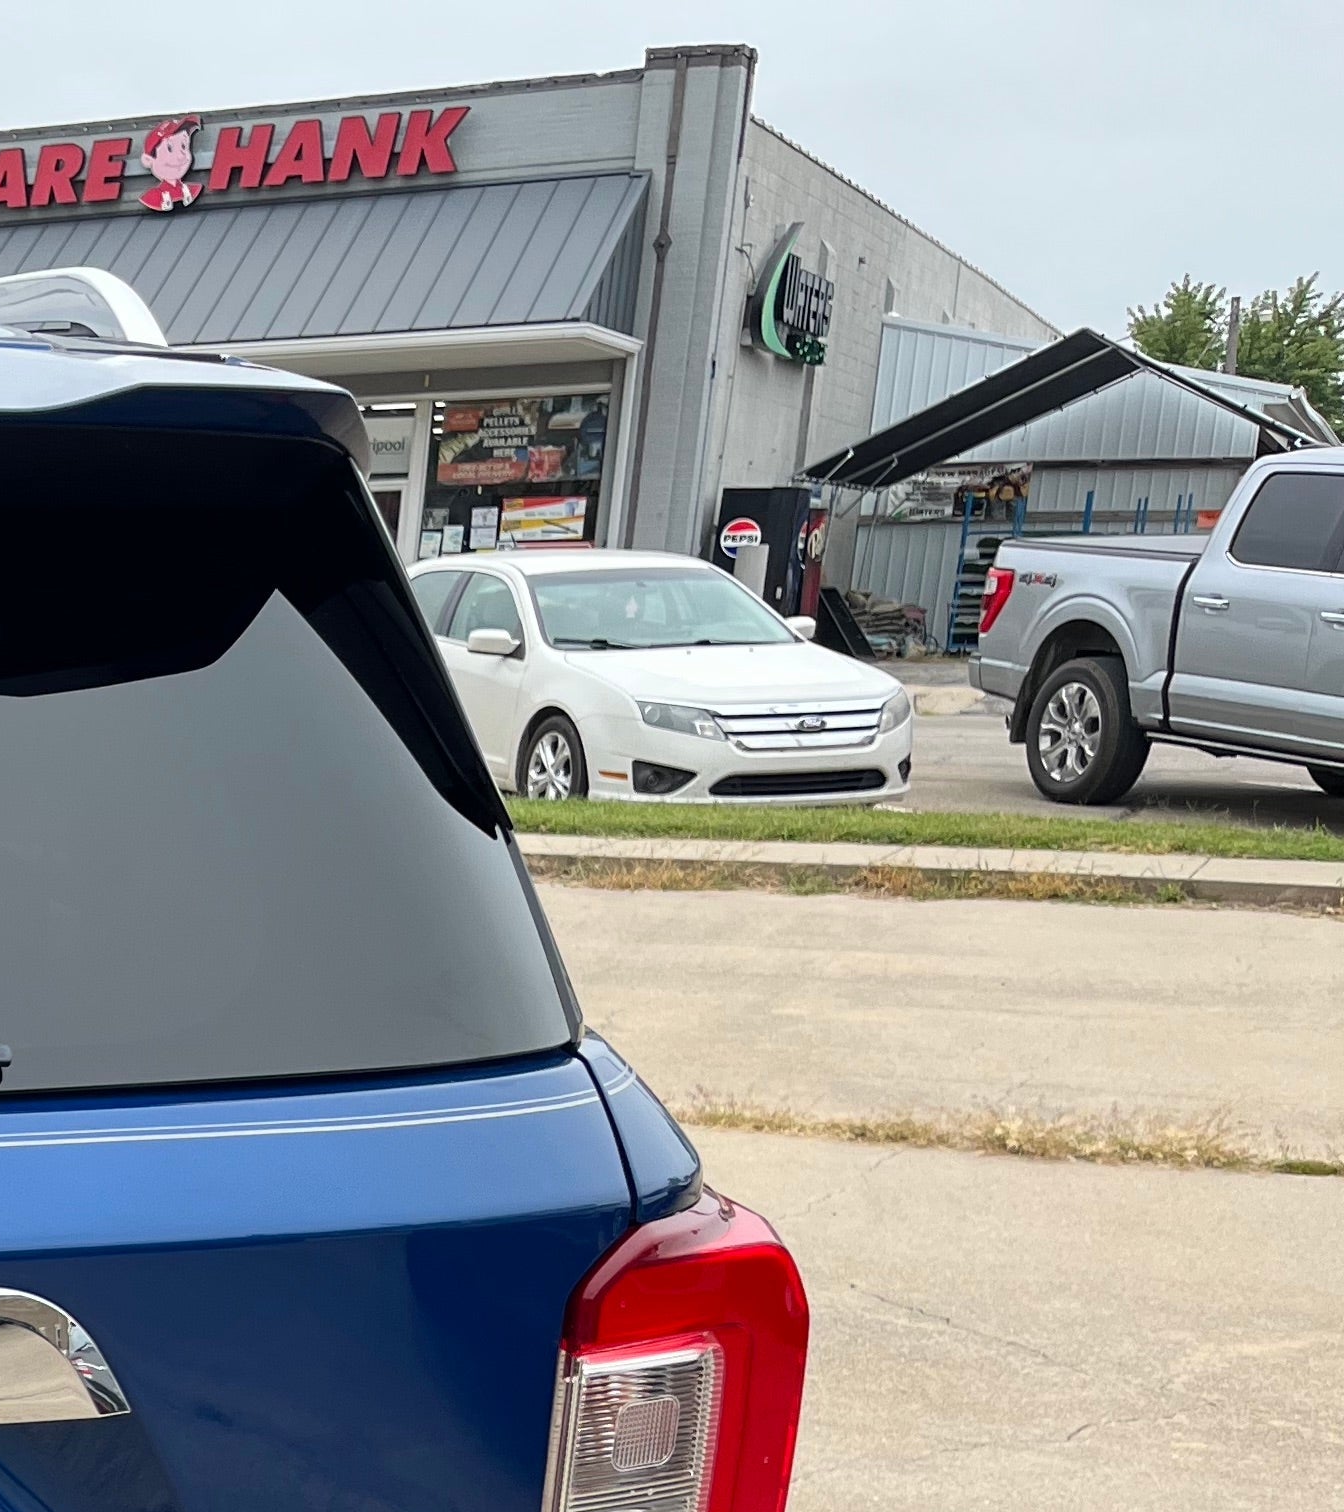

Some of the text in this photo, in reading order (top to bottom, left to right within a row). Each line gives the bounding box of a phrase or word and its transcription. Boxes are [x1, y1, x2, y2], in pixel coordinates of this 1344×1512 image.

[207, 106, 471, 190] HANK
[783, 253, 834, 337] WATERS
[483, 417, 520, 427] PELLETS
[478, 426, 537, 438] ACCESSORIES
[482, 437, 529, 448] AVAILABLE
[723, 534, 758, 543] PEPSI
